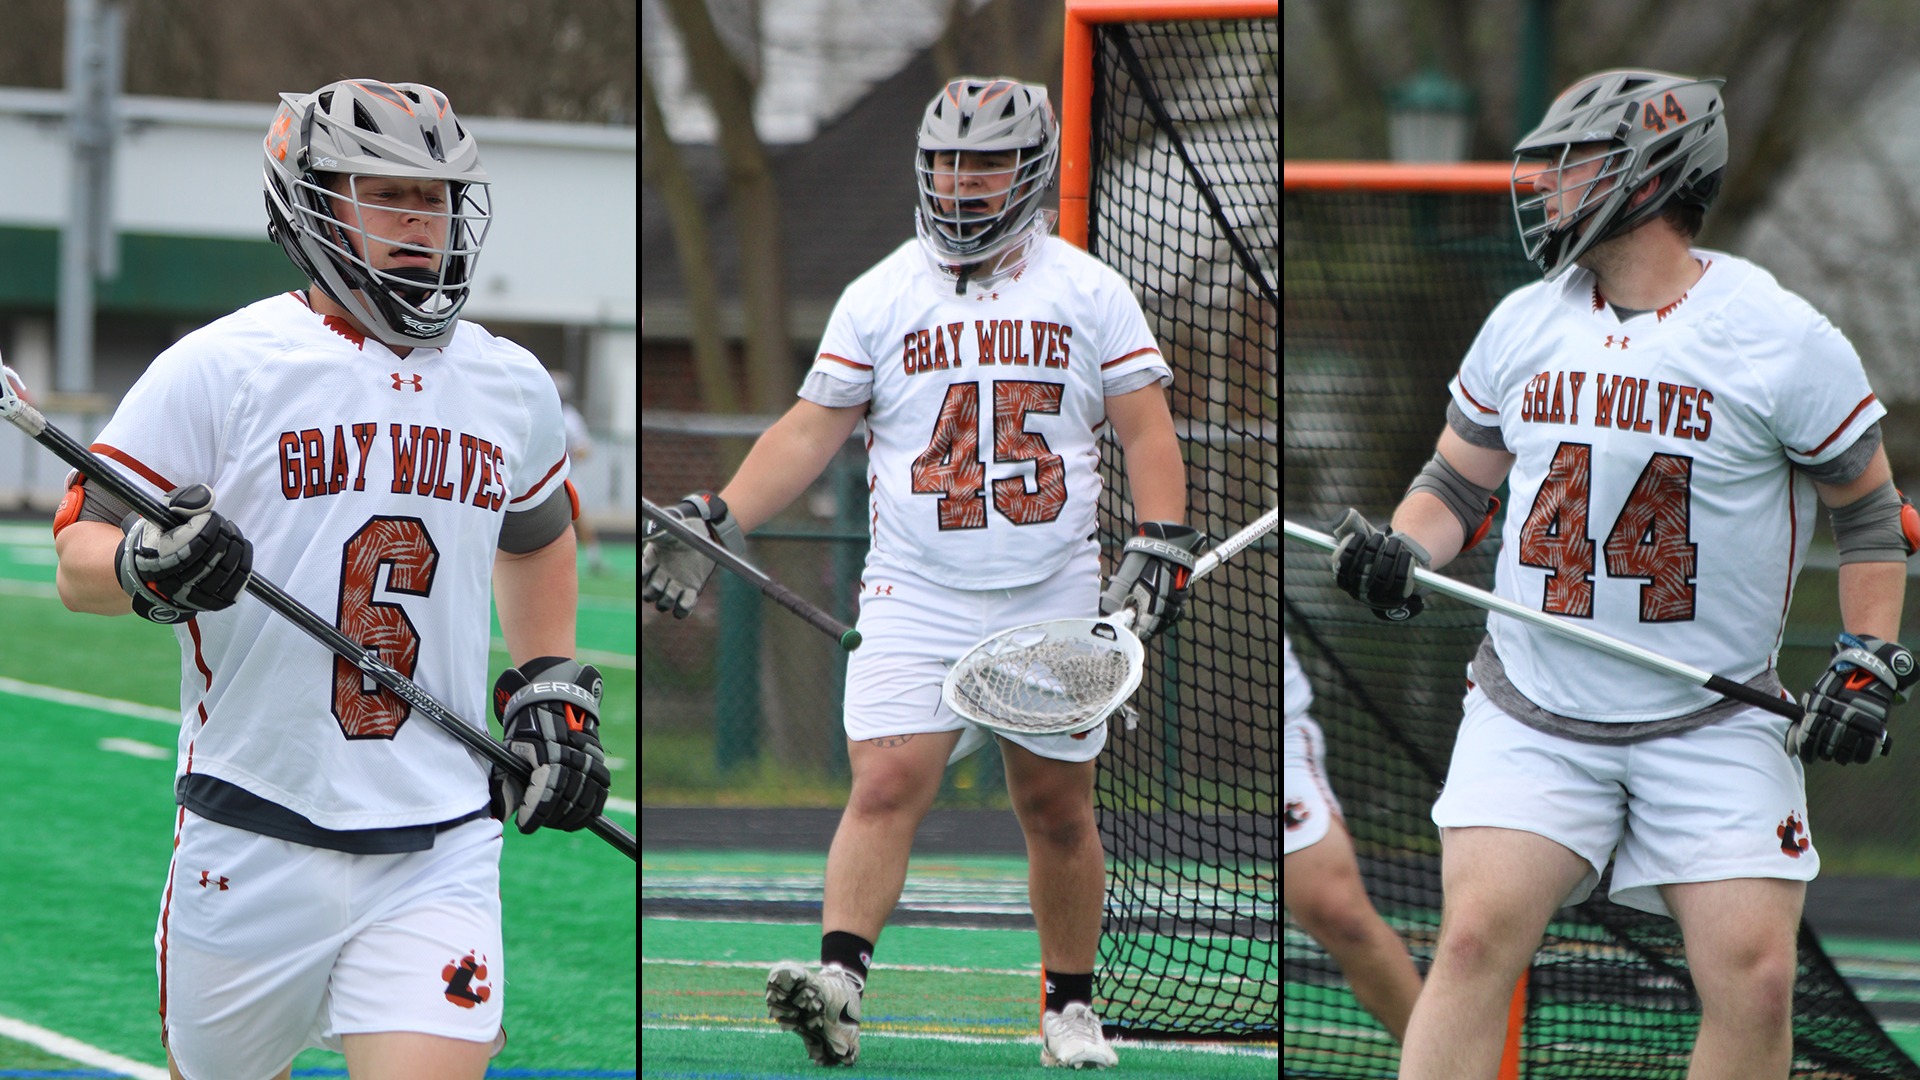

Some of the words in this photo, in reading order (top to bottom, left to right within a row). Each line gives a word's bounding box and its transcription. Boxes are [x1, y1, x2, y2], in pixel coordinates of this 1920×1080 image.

[1641, 91, 1688, 134] 44
[904, 323, 963, 374] GRAY
[975, 320, 1073, 370] WOLVES
[1521, 371, 1586, 424] GRAY
[1595, 374, 1714, 442] WOLVES
[279, 422, 377, 501] GRAY
[390, 423, 505, 513] WOLVES
[911, 380, 1068, 531] 45
[1519, 441, 1697, 623] 44
[331, 515, 440, 740] 6
